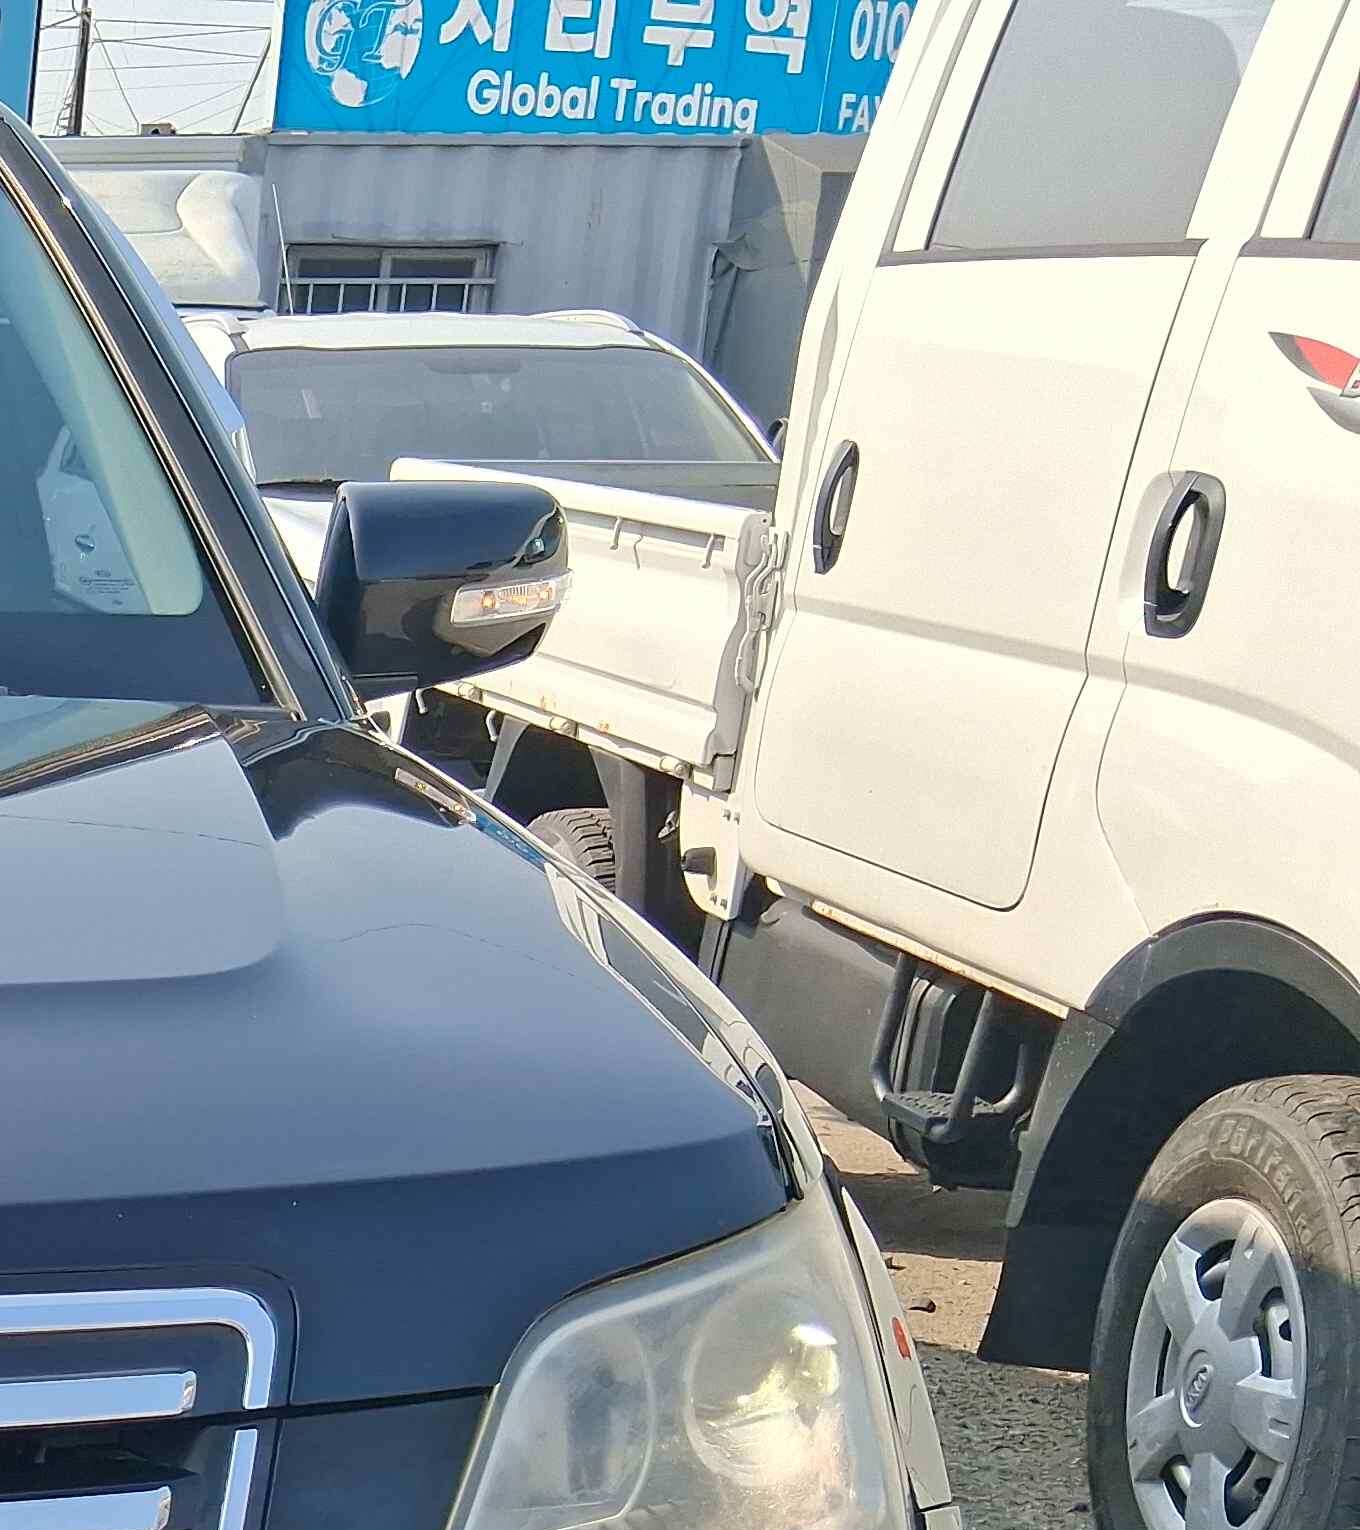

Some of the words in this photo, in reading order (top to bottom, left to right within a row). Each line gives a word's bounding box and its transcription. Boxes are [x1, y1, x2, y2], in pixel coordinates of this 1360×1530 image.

[467, 69, 600, 120] Global
[610, 77, 759, 135] Trading
[838, 93, 882, 133] FA
